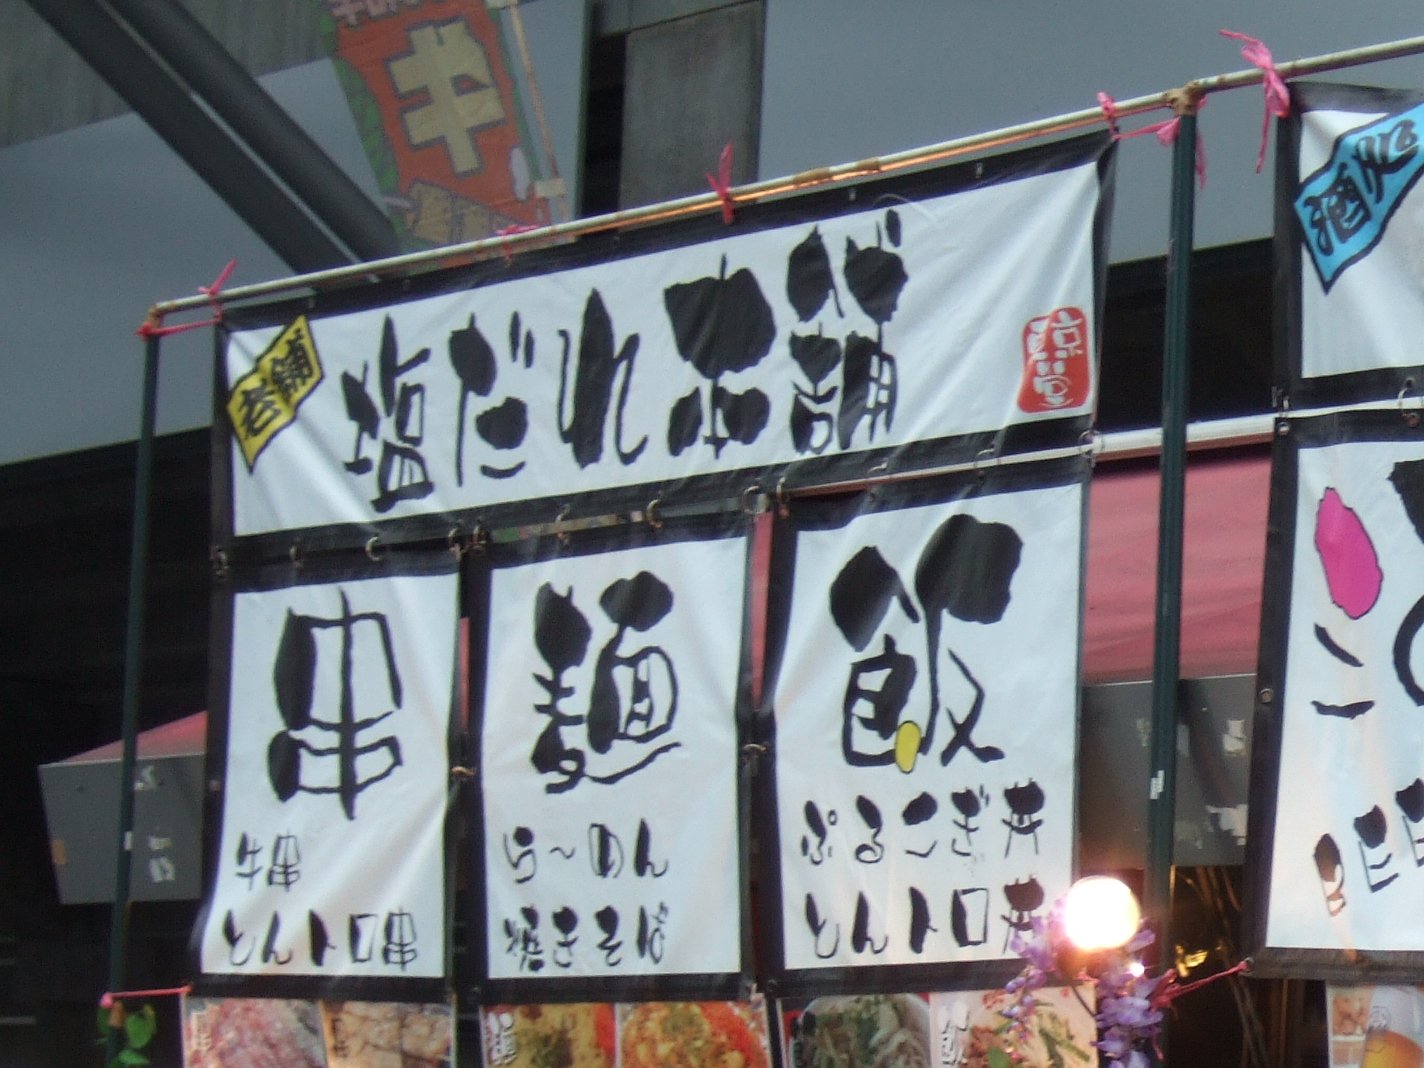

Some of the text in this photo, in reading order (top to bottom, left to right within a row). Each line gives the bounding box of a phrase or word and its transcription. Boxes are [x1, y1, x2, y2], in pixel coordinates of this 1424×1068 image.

[829, 513, 1024, 773] 飯
[267, 586, 403, 821] 串
[236, 828, 301, 892] 牛串
[223, 905, 418, 971] とんトロ串
[504, 901, 669, 972] 焼きそば
